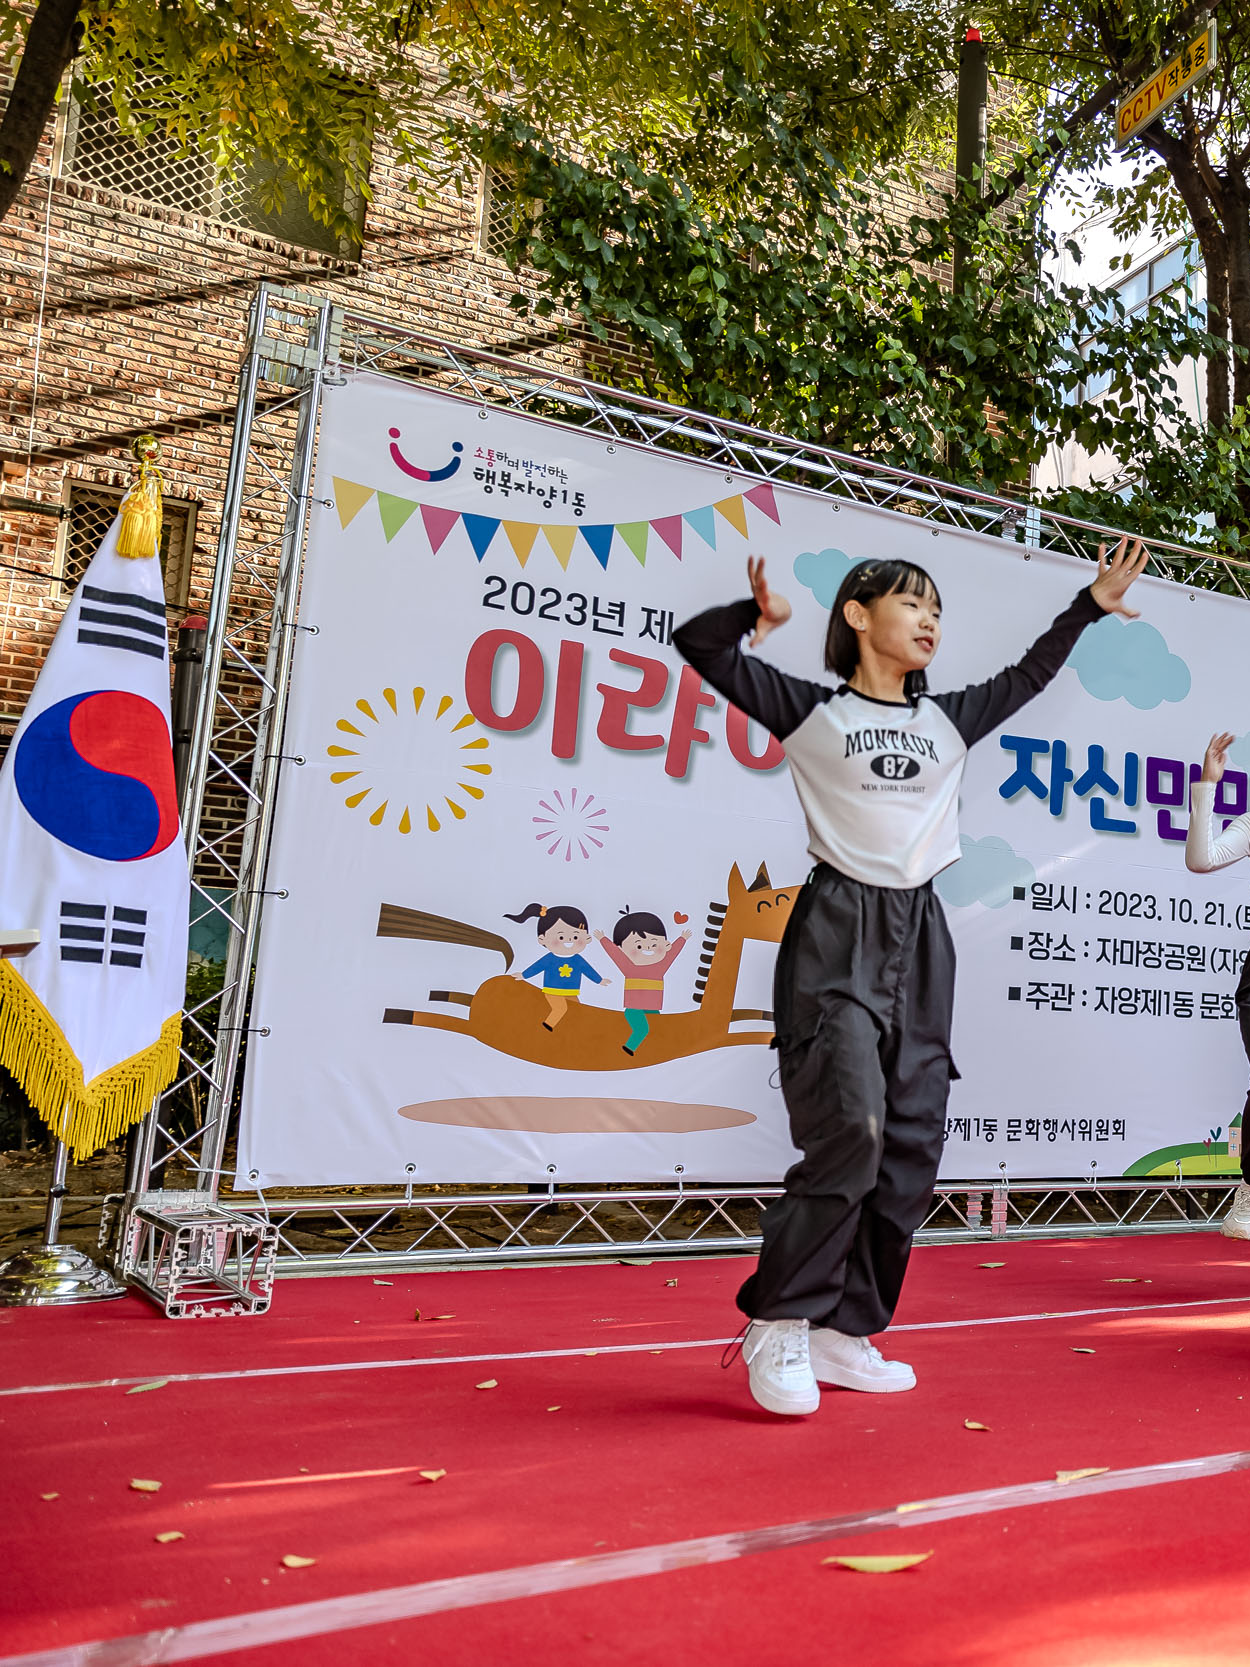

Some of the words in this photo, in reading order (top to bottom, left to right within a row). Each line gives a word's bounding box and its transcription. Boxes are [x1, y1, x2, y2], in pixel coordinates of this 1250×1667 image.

[473, 446, 519, 468] 소통하며
[522, 459, 569, 485] 발전하는
[473, 466, 586, 517] 행복자양1동
[482, 575, 626, 637] 2023년
[844, 728, 940, 764] MONTAUK
[883, 755, 910, 778] 87
[861, 783, 878, 792] NEW
[880, 784, 899, 792] YORK
[900, 785, 926, 794] TOURIST
[1031, 882, 1077, 914] 일시
[1098, 889, 1163, 922] 2023.
[1169, 897, 1198, 925] 10.
[1028, 931, 1076, 962] 장소
[1025, 981, 1076, 1012] 주관
[1094, 985, 1195, 1019] 자양제1동
[1006, 1118, 1126, 1143] 문화행사위원회
